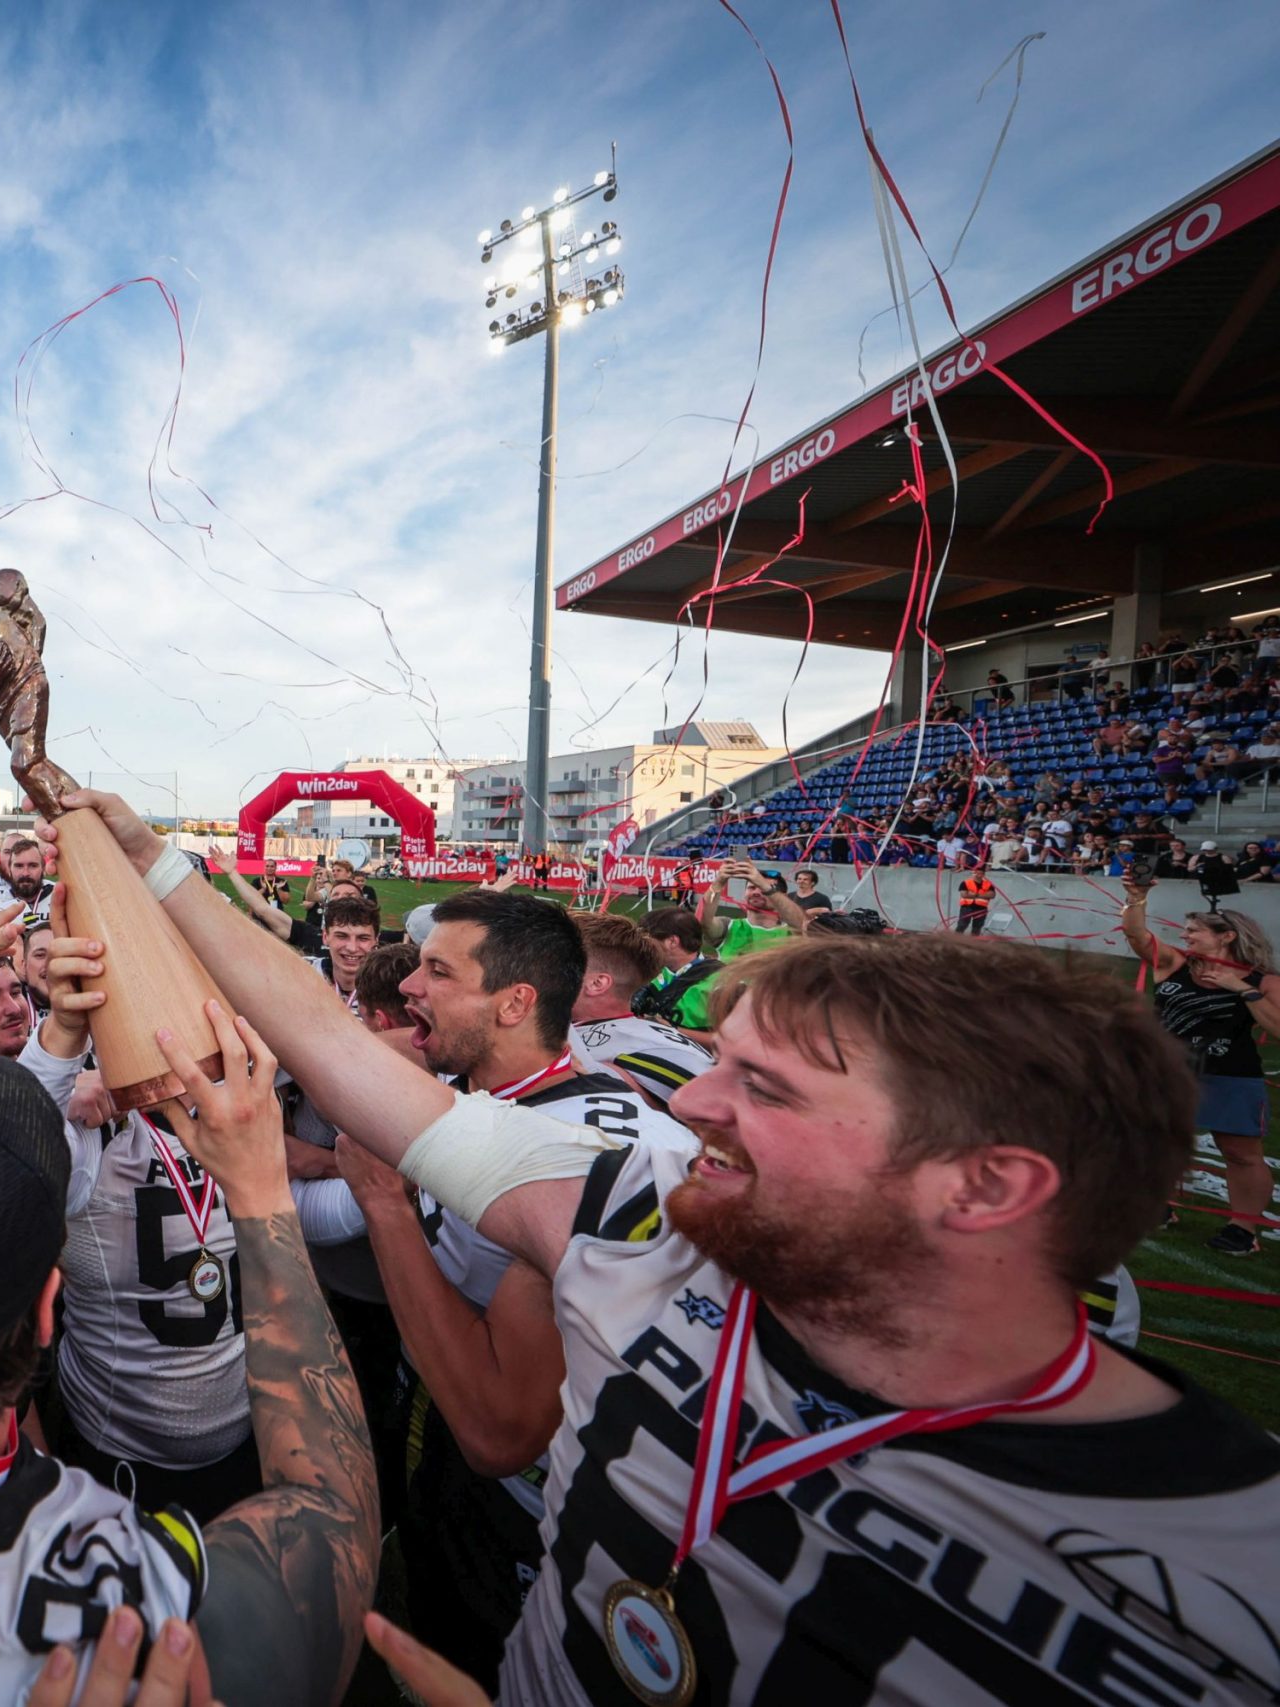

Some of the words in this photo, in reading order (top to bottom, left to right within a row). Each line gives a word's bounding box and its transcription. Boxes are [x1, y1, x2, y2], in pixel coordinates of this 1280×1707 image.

[1071, 202, 1222, 314] ERGO
[891, 341, 987, 416] ERGO
[770, 429, 836, 485] ERGO
[682, 490, 731, 535] ERGO
[617, 536, 655, 572] ERGO
[566, 571, 596, 601] ERGO
[641, 766, 676, 778] city
[296, 777, 358, 795] win2day
[239, 837, 255, 846] Fair
[405, 843, 426, 853] Fair
[407, 857, 487, 877] win2day
[507, 863, 586, 880] winday
